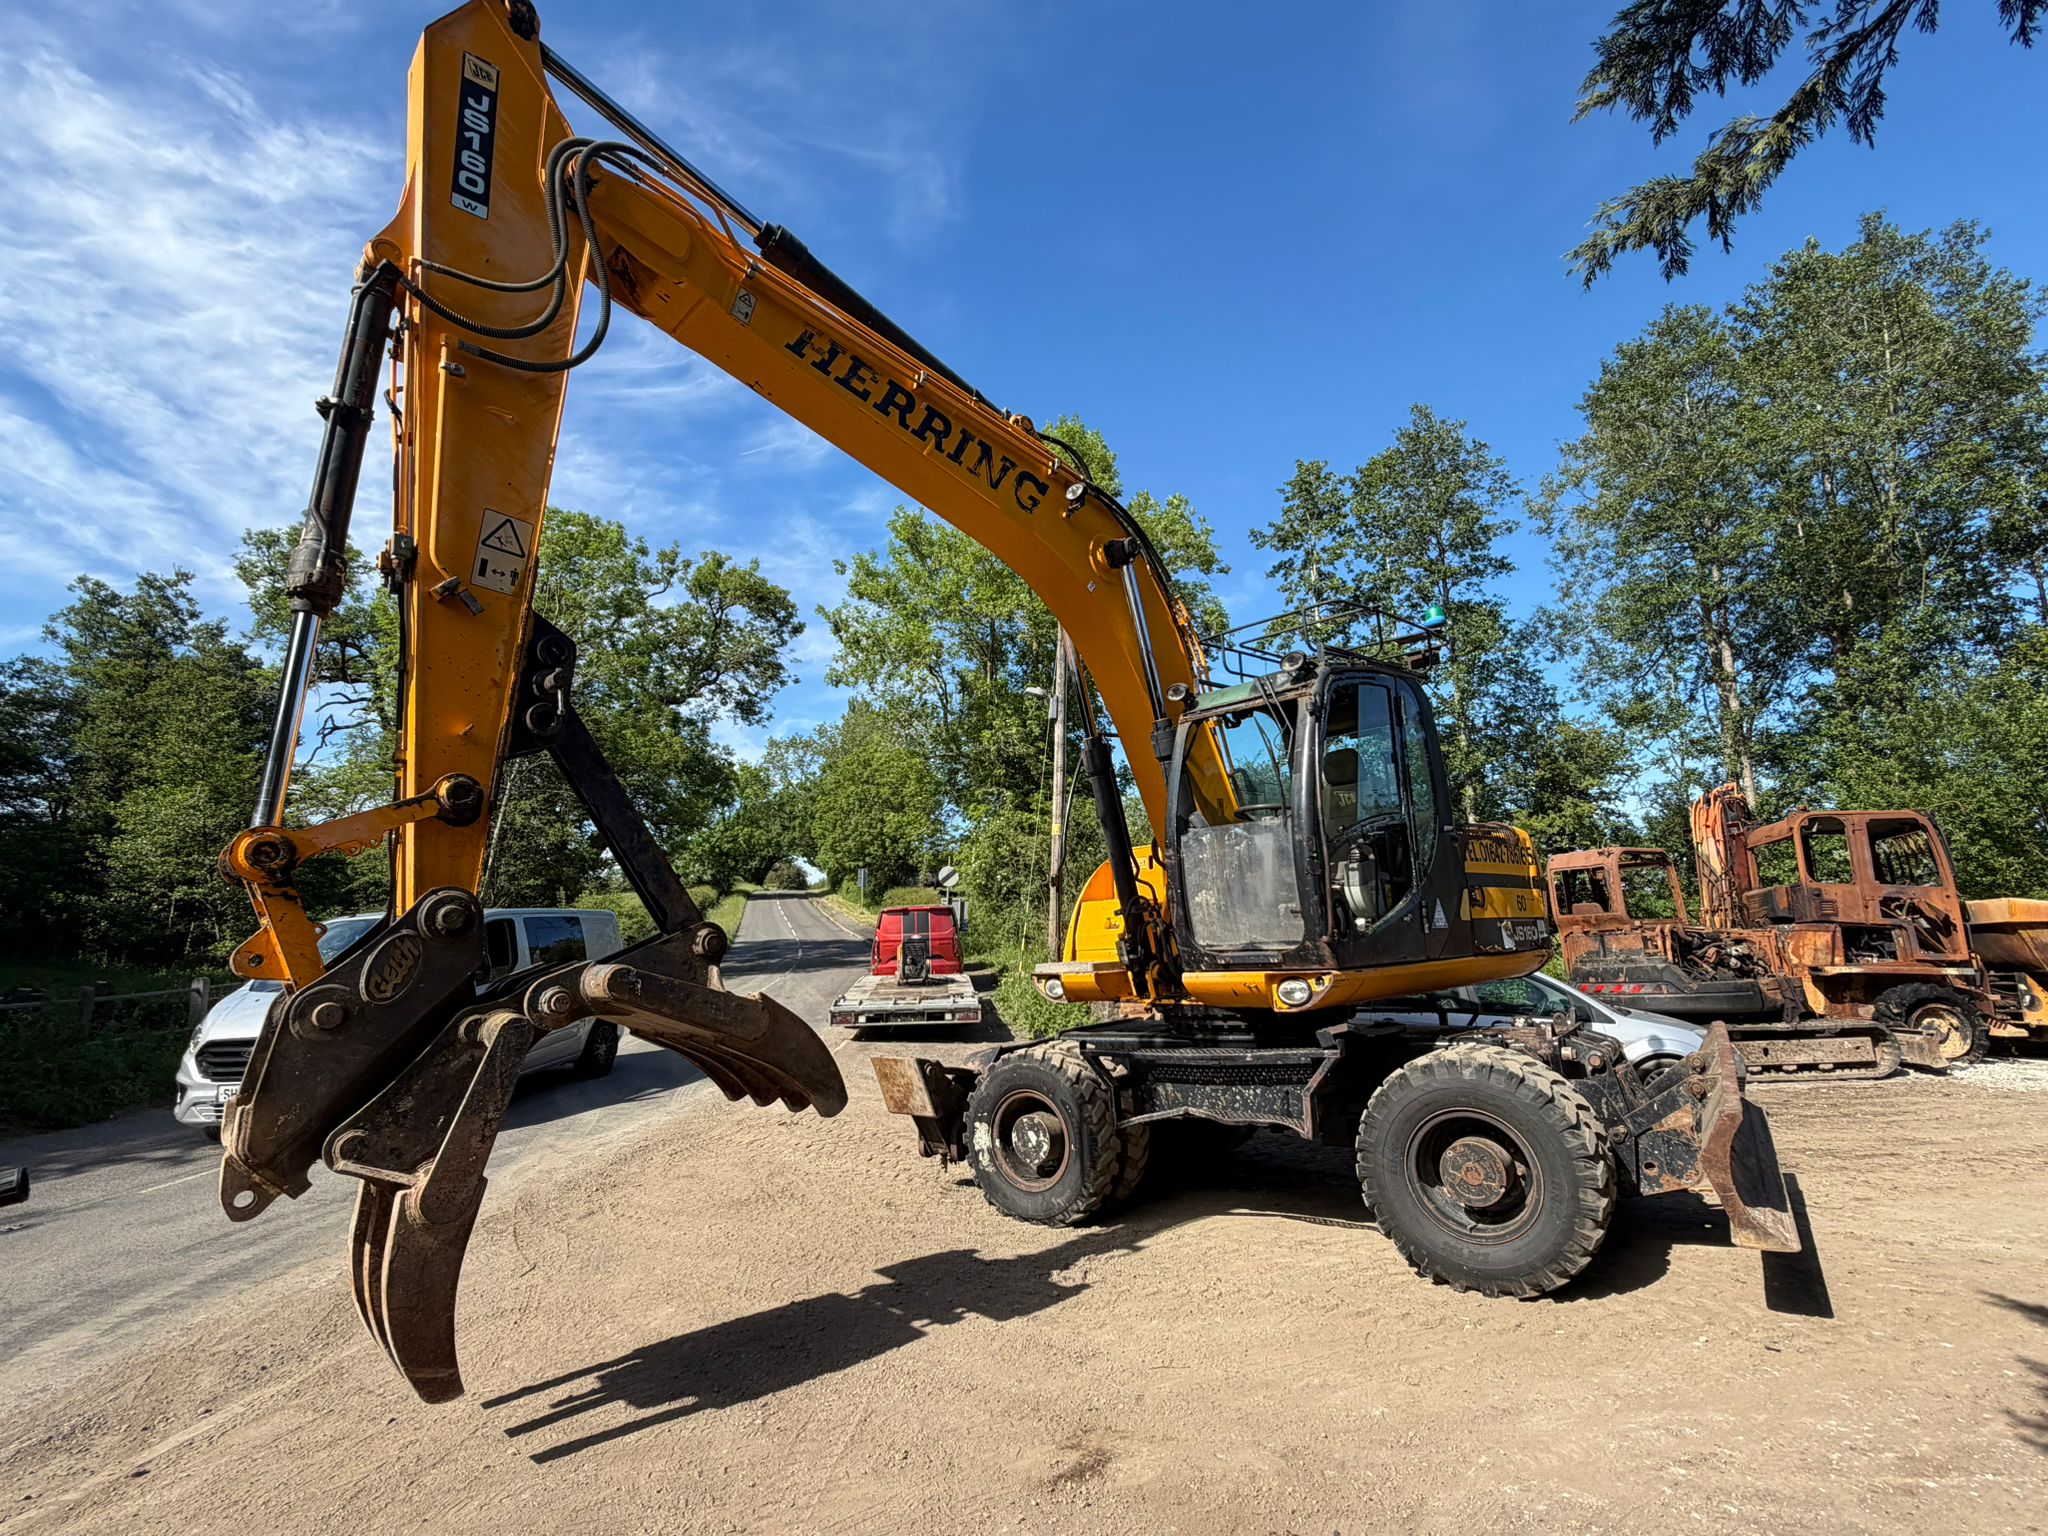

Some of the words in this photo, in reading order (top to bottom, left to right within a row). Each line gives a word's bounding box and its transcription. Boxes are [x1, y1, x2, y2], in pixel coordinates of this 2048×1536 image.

[470, 60, 494, 83] JCB
[458, 94, 490, 195] JS160
[784, 324, 1049, 515] HERRING
[1338, 792, 1356, 807] JCB
